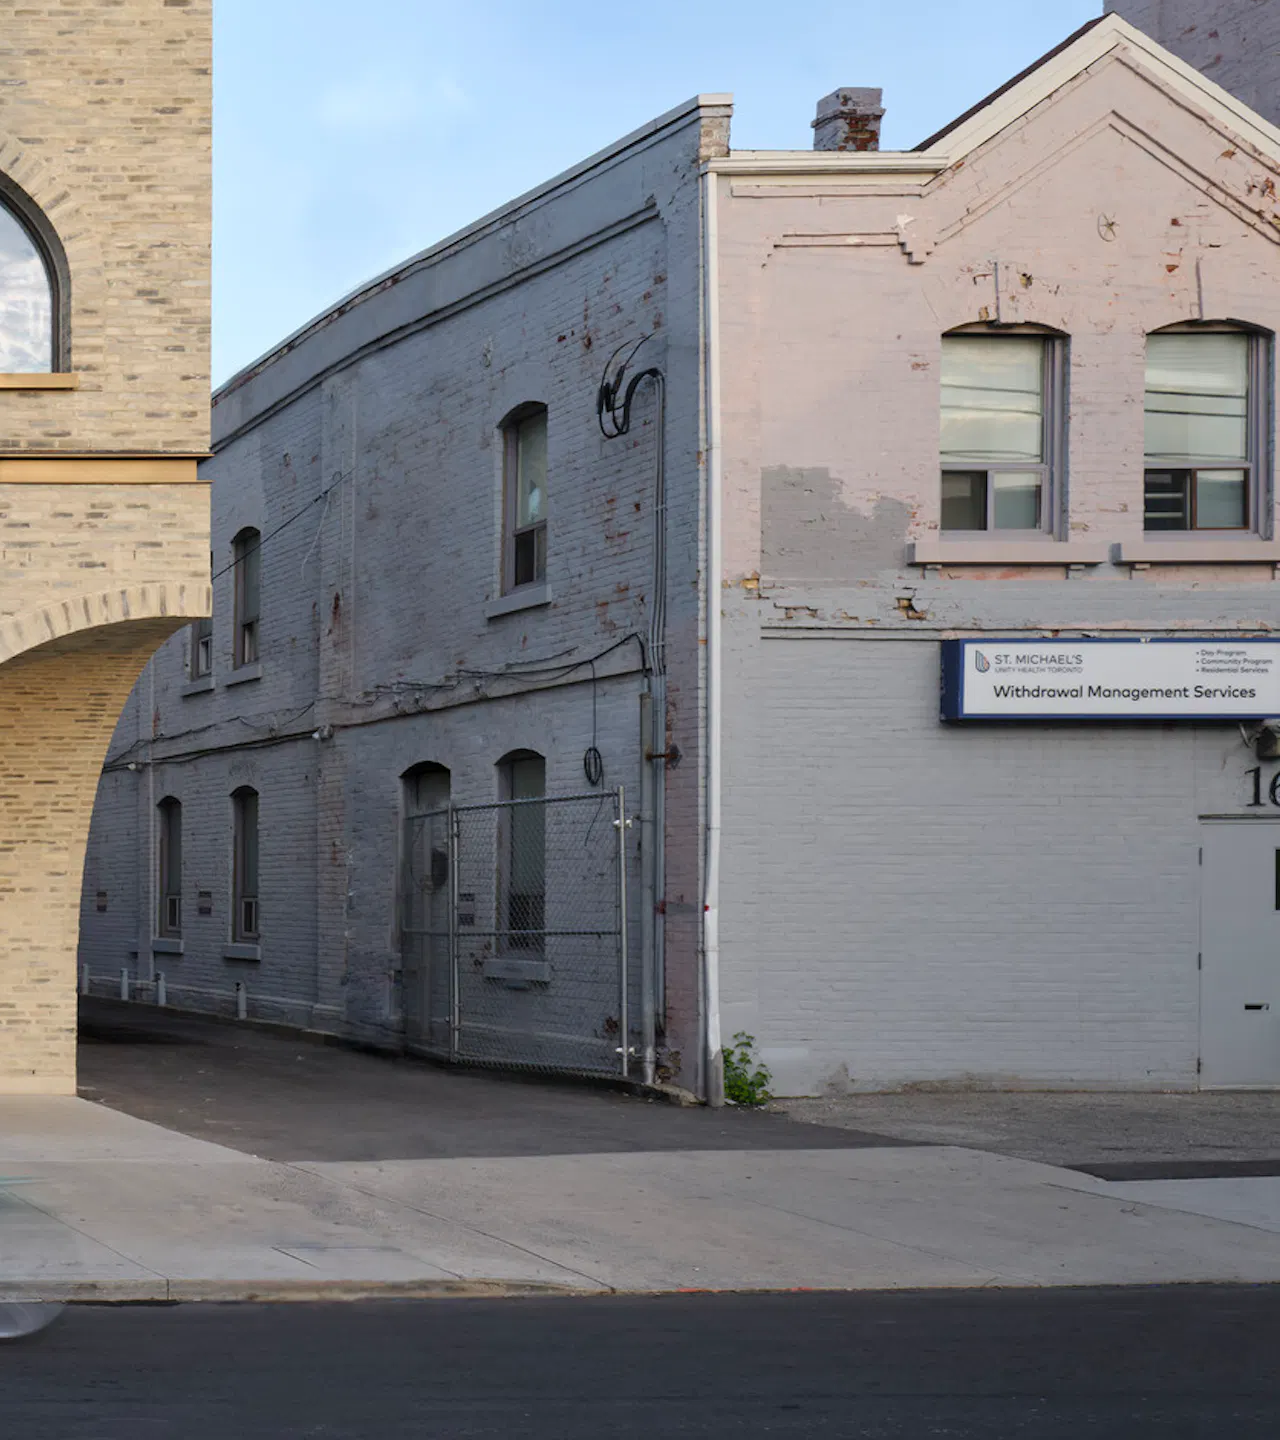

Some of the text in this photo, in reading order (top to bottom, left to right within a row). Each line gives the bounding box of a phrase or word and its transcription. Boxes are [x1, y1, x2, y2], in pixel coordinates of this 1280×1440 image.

[994, 654, 1083, 665] ST. MICHAEL'S
[993, 685, 1256, 701] Withdrawal Management Services
